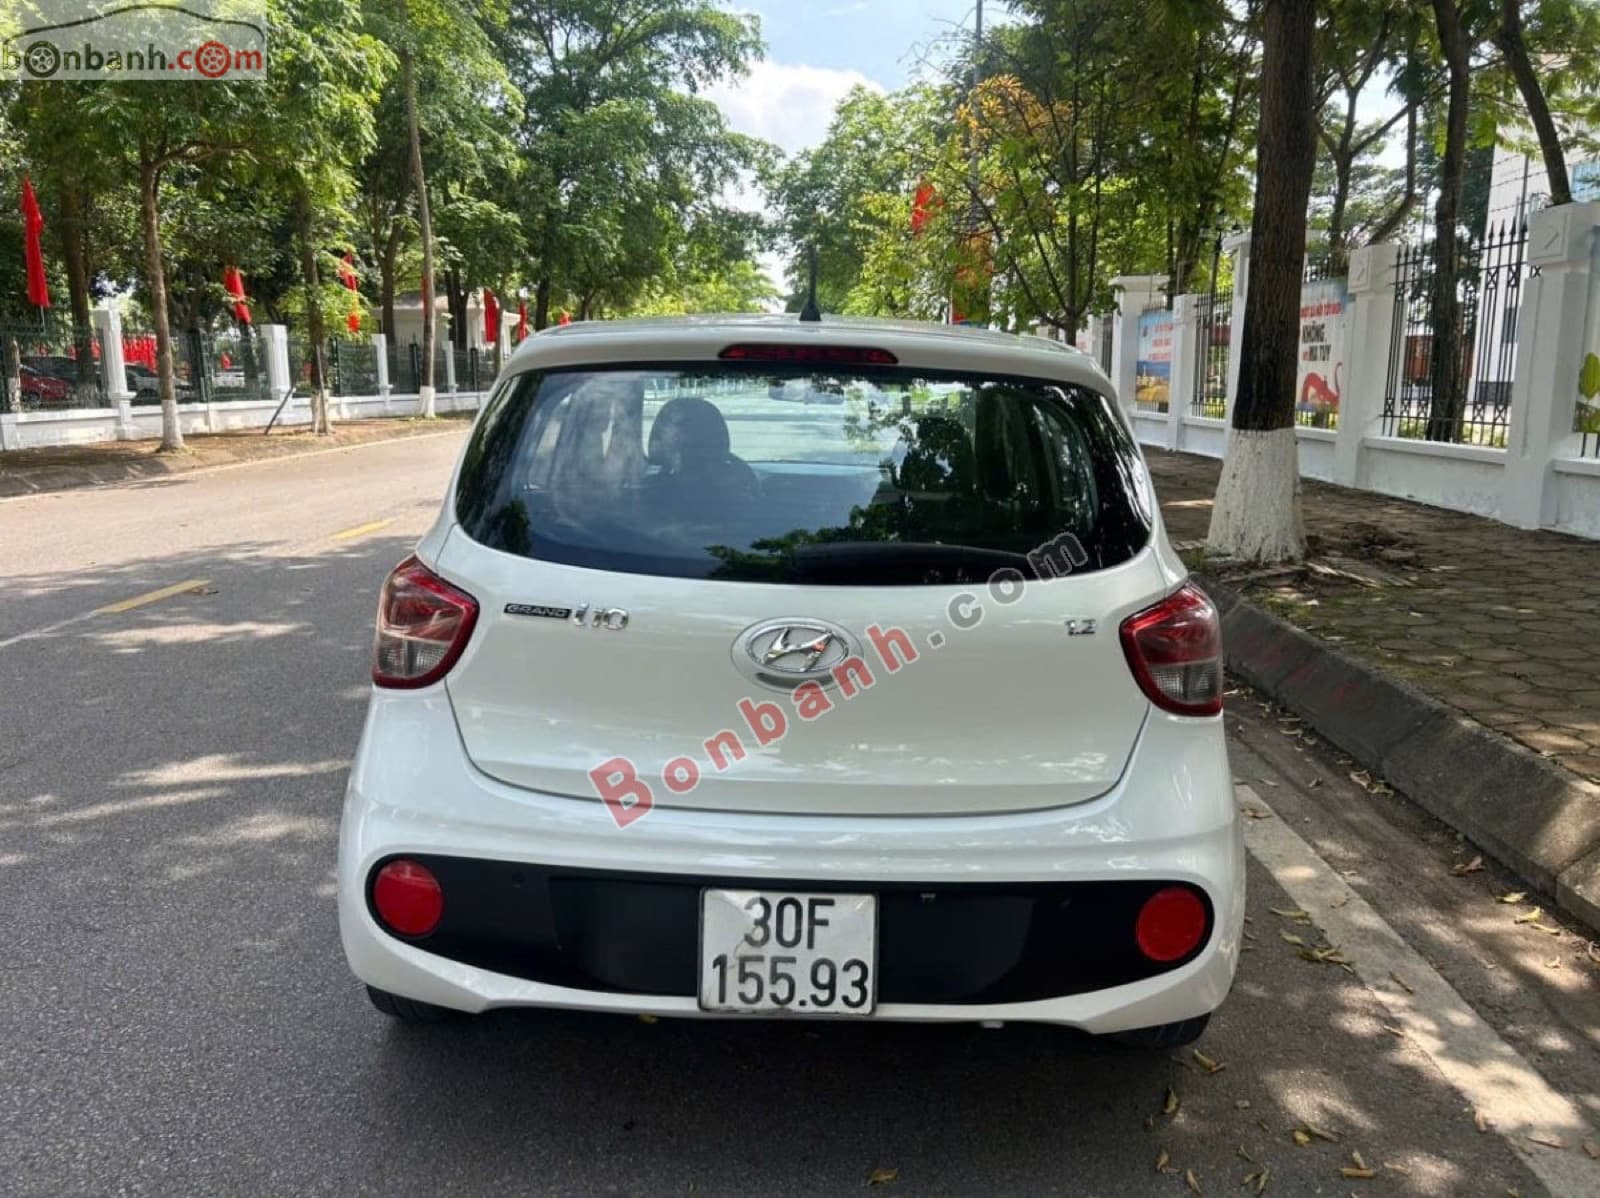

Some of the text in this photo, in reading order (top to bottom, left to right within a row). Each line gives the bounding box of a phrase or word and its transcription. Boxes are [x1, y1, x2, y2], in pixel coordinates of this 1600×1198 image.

[506, 601, 629, 631] GRAND i10
[744, 896, 835, 950] 30F
[712, 954, 869, 1008] 155.93
